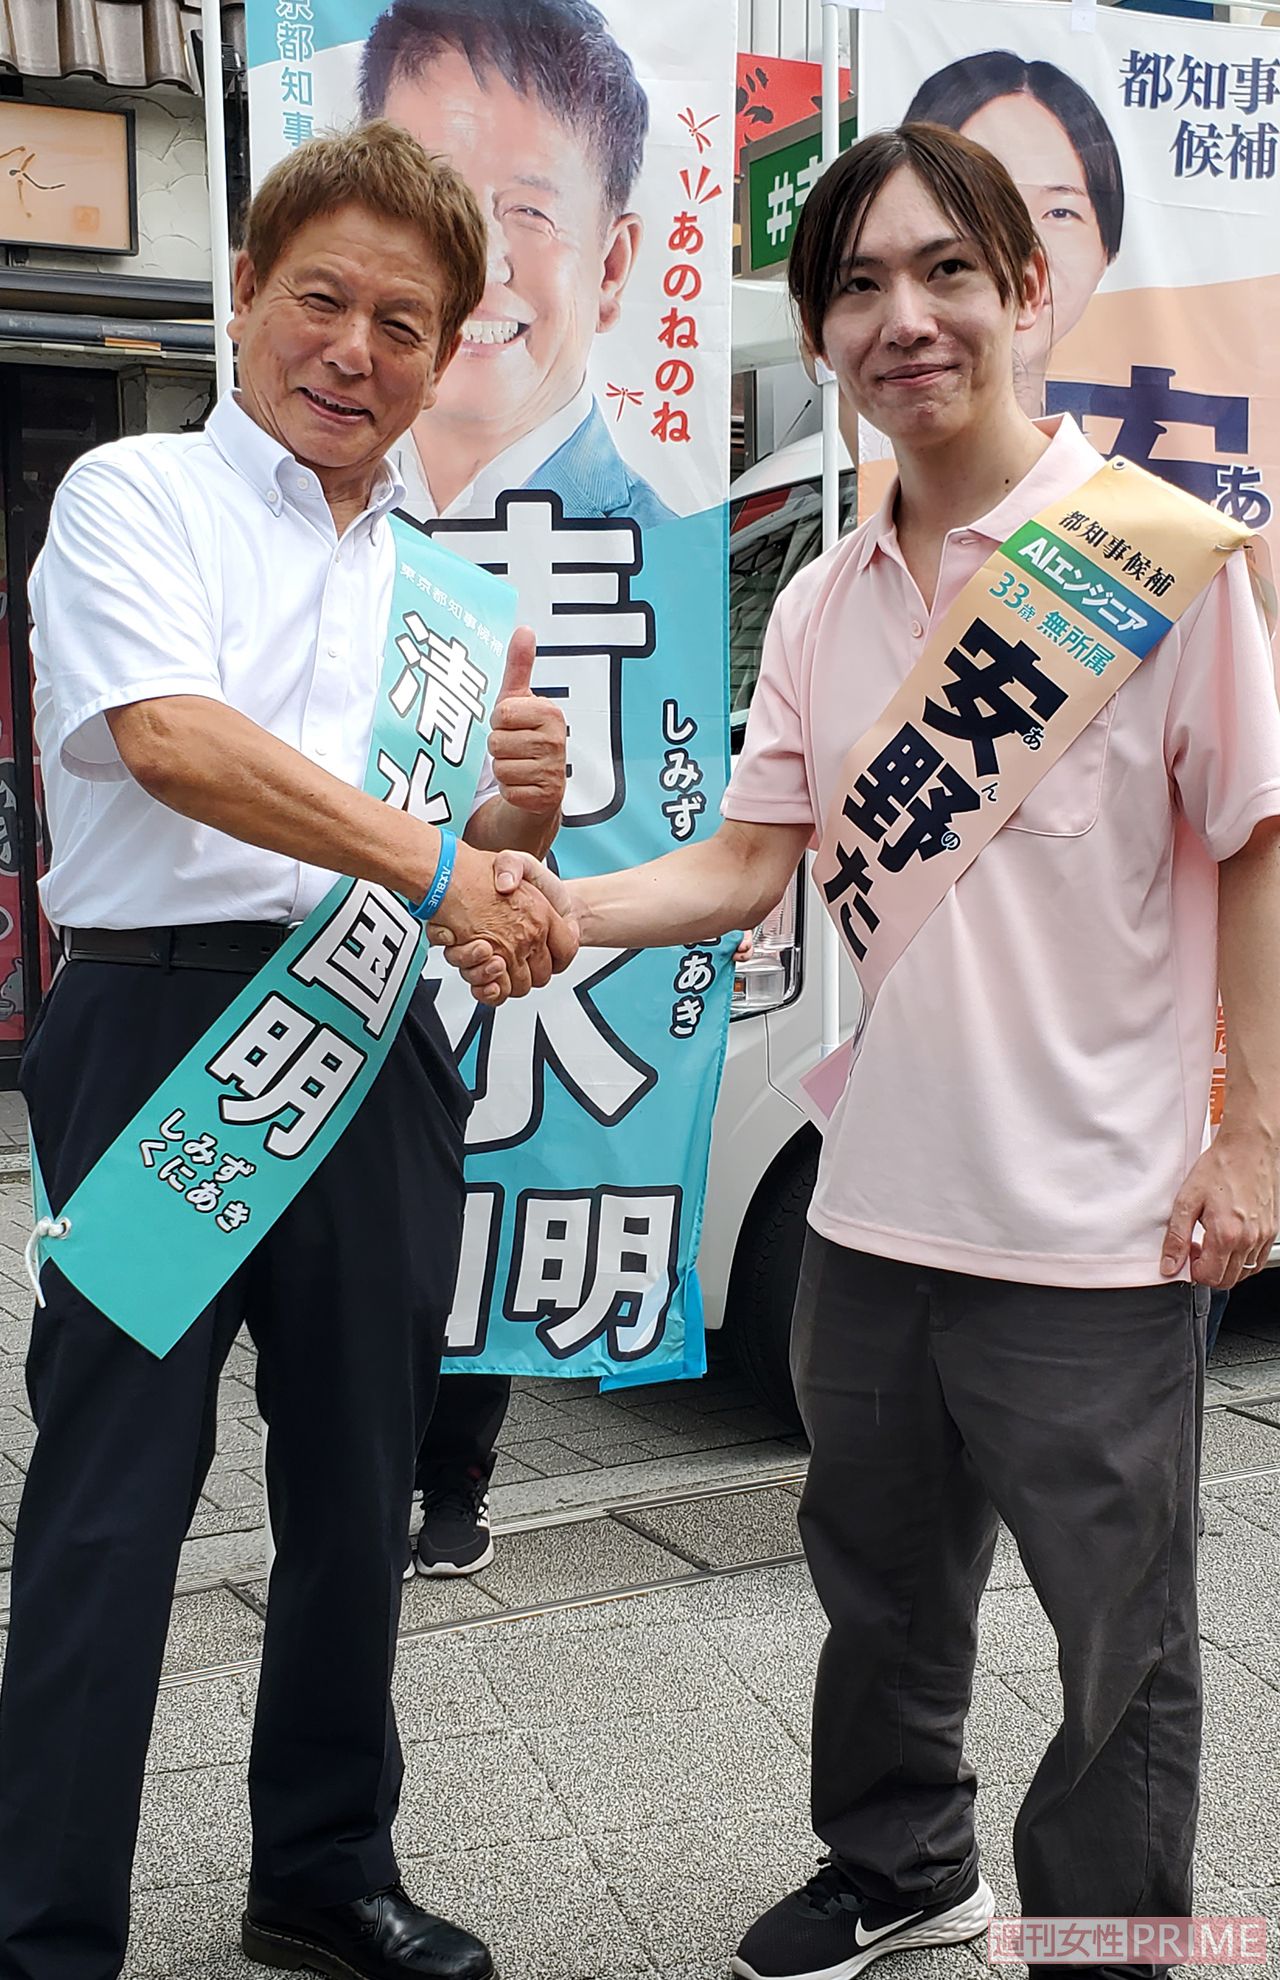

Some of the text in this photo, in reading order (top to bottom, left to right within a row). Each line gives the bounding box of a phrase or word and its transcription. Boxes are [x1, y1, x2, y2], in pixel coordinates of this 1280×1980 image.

[1118, 49, 1280, 116] 都知事
[1168, 119, 1280, 180] 候補
[650, 209, 705, 444] あのねのね
[1018, 536, 1149, 632] AIエンジニア
[1058, 510, 1176, 597] 都知事候補
[400, 561, 505, 657] 東京都知事候補
[988, 571, 1116, 677] 33歳 無所属
[823, 616, 1070, 962] 安野た
[660, 698, 722, 1039] しみず あき
[138, 1137, 252, 1234] くにあき
[158, 1108, 257, 1183] しみず
